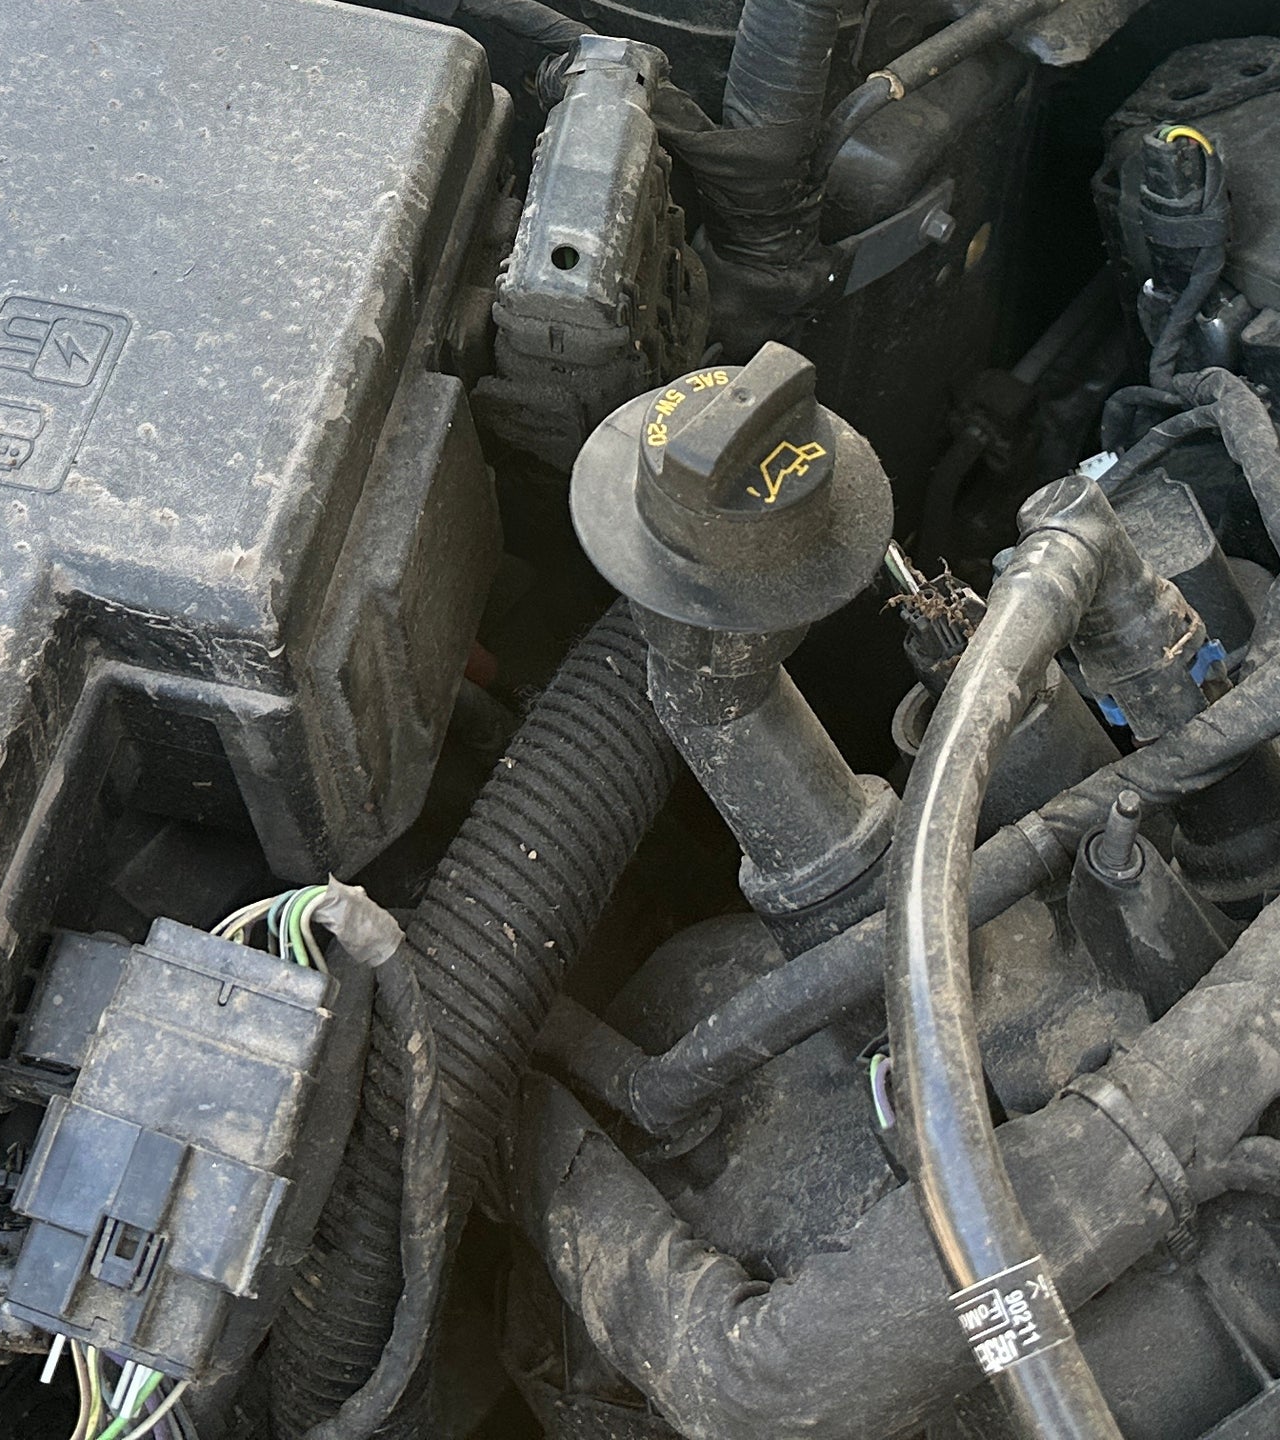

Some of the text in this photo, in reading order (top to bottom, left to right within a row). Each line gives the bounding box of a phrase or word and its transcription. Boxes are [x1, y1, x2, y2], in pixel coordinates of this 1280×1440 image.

[647, 370, 729, 446] SAE 5W-20
[1004, 1289, 1041, 1347] 90211
